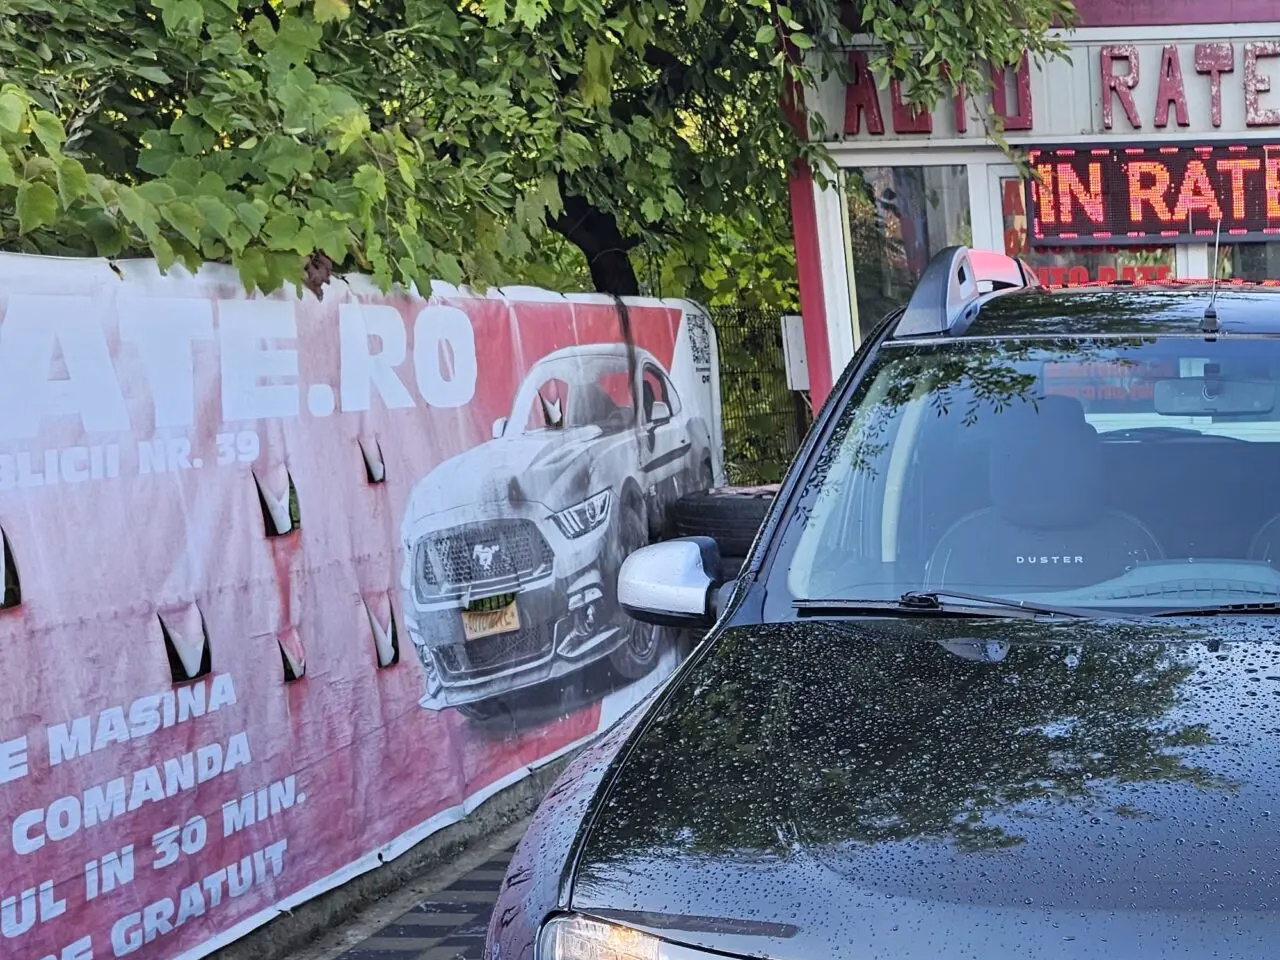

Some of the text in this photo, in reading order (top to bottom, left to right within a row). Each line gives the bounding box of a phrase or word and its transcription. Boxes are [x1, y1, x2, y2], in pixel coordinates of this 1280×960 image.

[1037, 161, 1104, 224] IN
[137, 436, 204, 475] NR.
[215, 429, 260, 466] 39
[1016, 555, 1084, 565] DUSTER
[47, 673, 238, 768] MASINA
[11, 731, 253, 856] COMANDA
[85, 845, 135, 902] IN
[151, 814, 207, 871] 30
[223, 774, 307, 838] MIN.
[110, 839, 288, 959] GRATUIT
